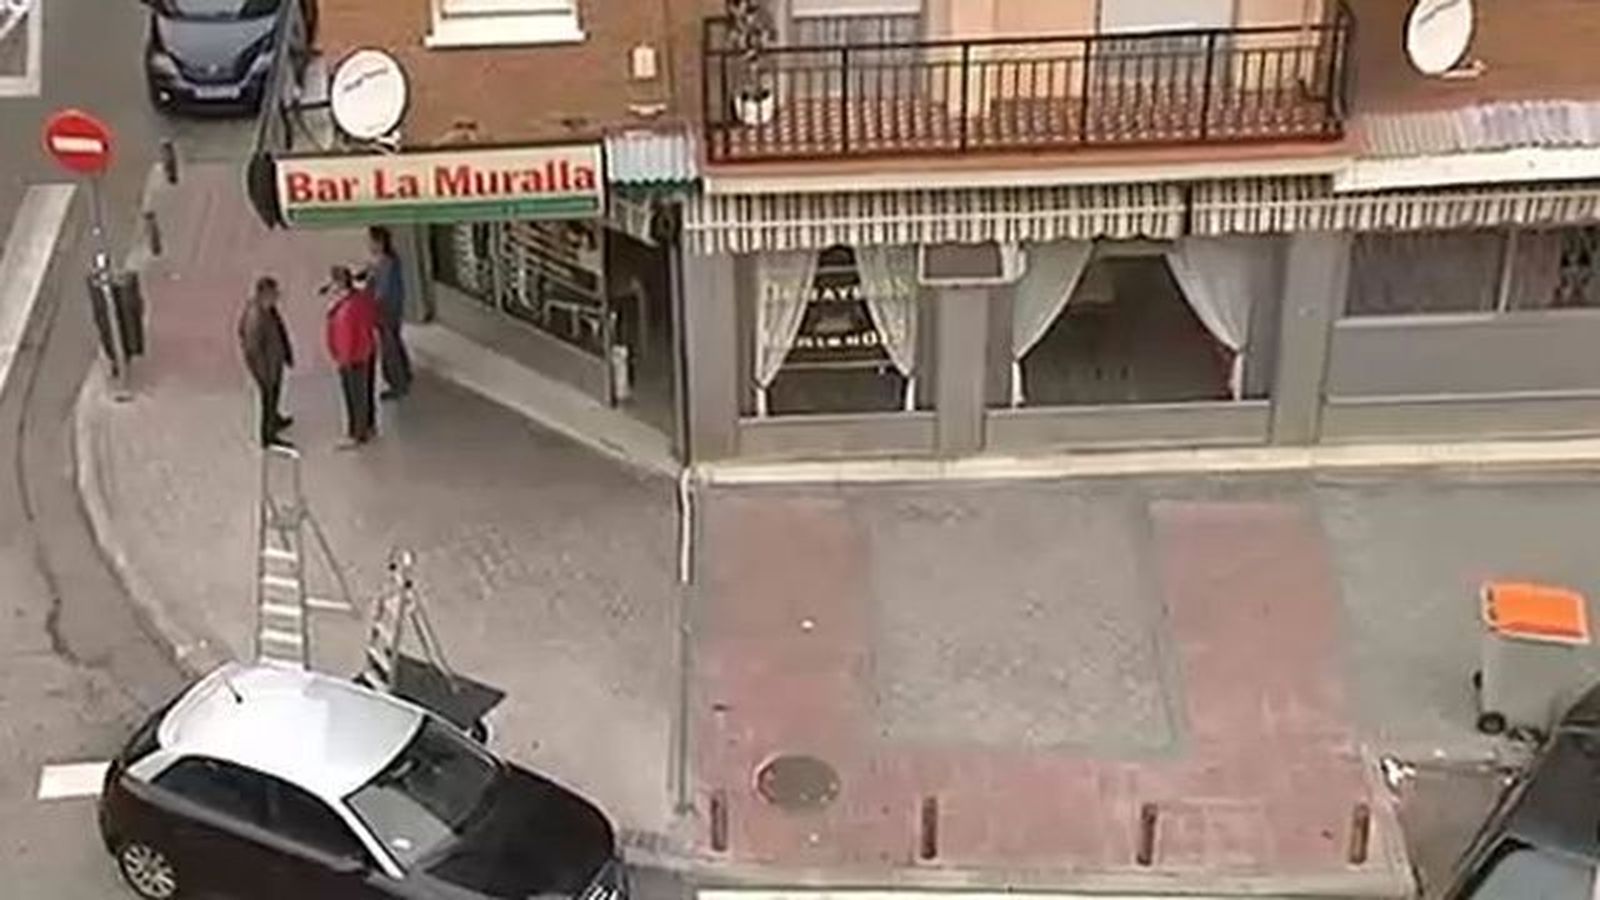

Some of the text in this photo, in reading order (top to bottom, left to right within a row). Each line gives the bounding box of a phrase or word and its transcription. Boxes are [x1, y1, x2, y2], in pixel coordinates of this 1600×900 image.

[286, 160, 596, 203] Bar La Muralla
